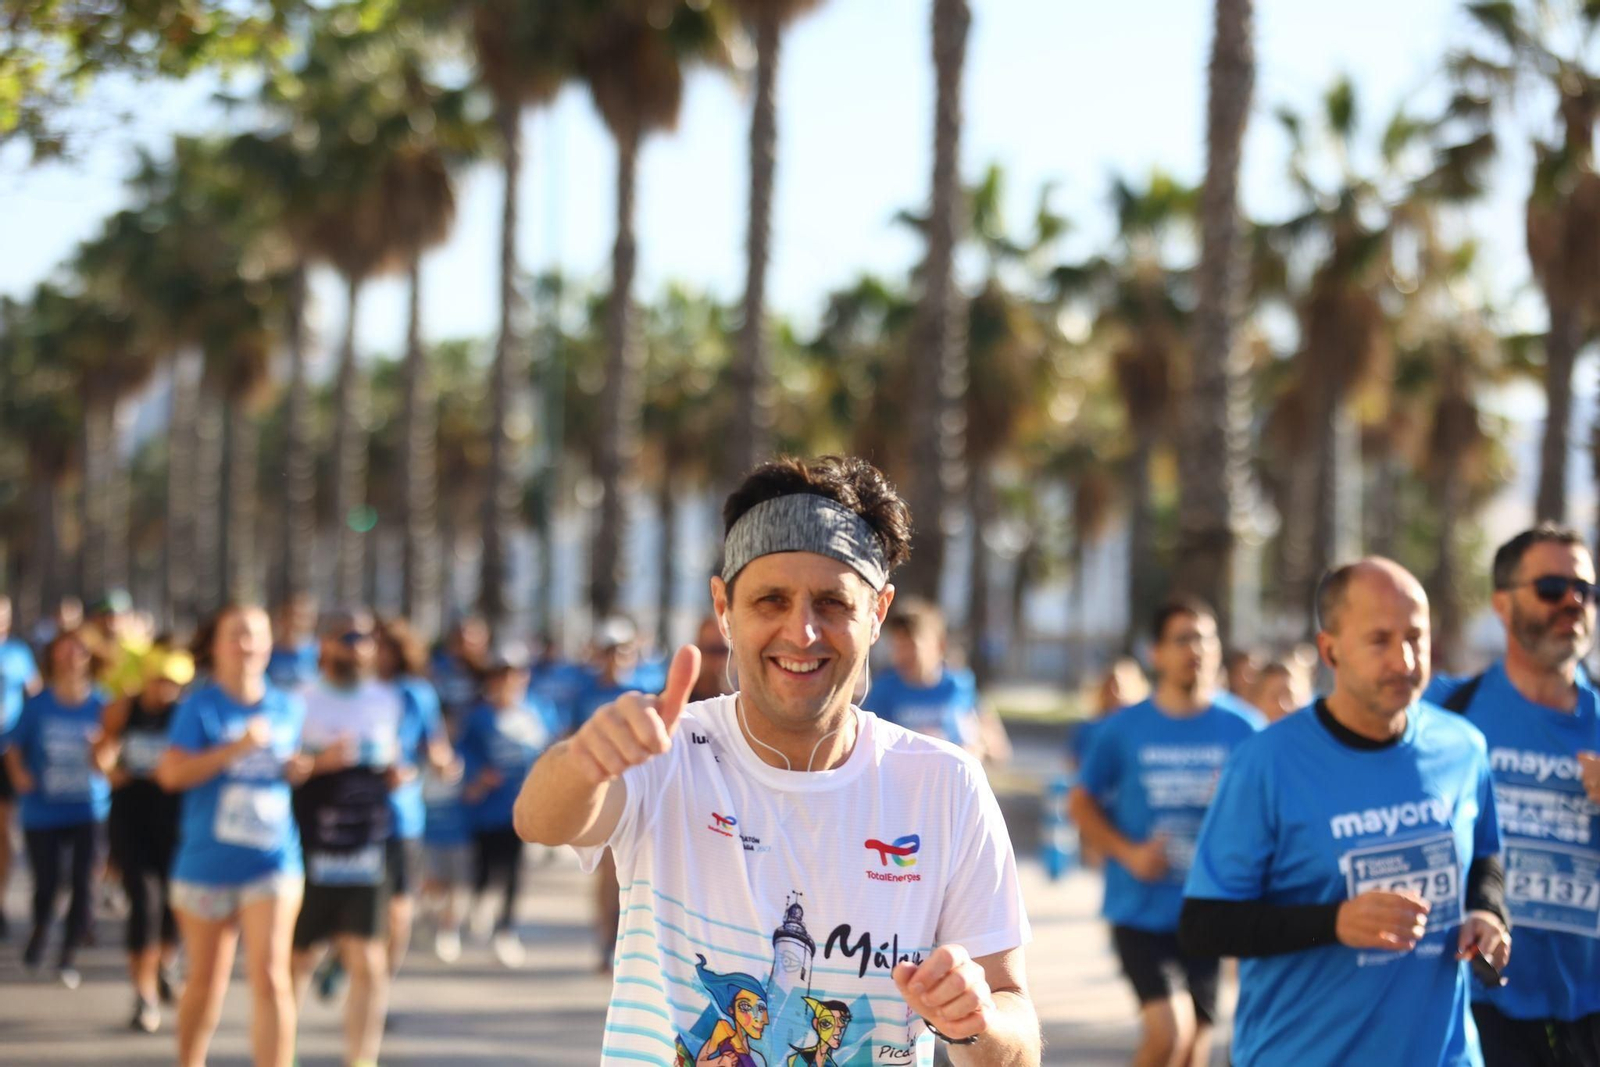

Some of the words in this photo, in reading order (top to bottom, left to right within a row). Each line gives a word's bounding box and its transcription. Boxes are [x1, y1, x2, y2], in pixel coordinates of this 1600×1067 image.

[1491, 746, 1584, 782] mayor
[1330, 798, 1452, 839] mayor
[866, 870, 921, 882] TotalEnerges
[1512, 875, 1592, 906] 2137
[878, 1045, 910, 1059] Pica
